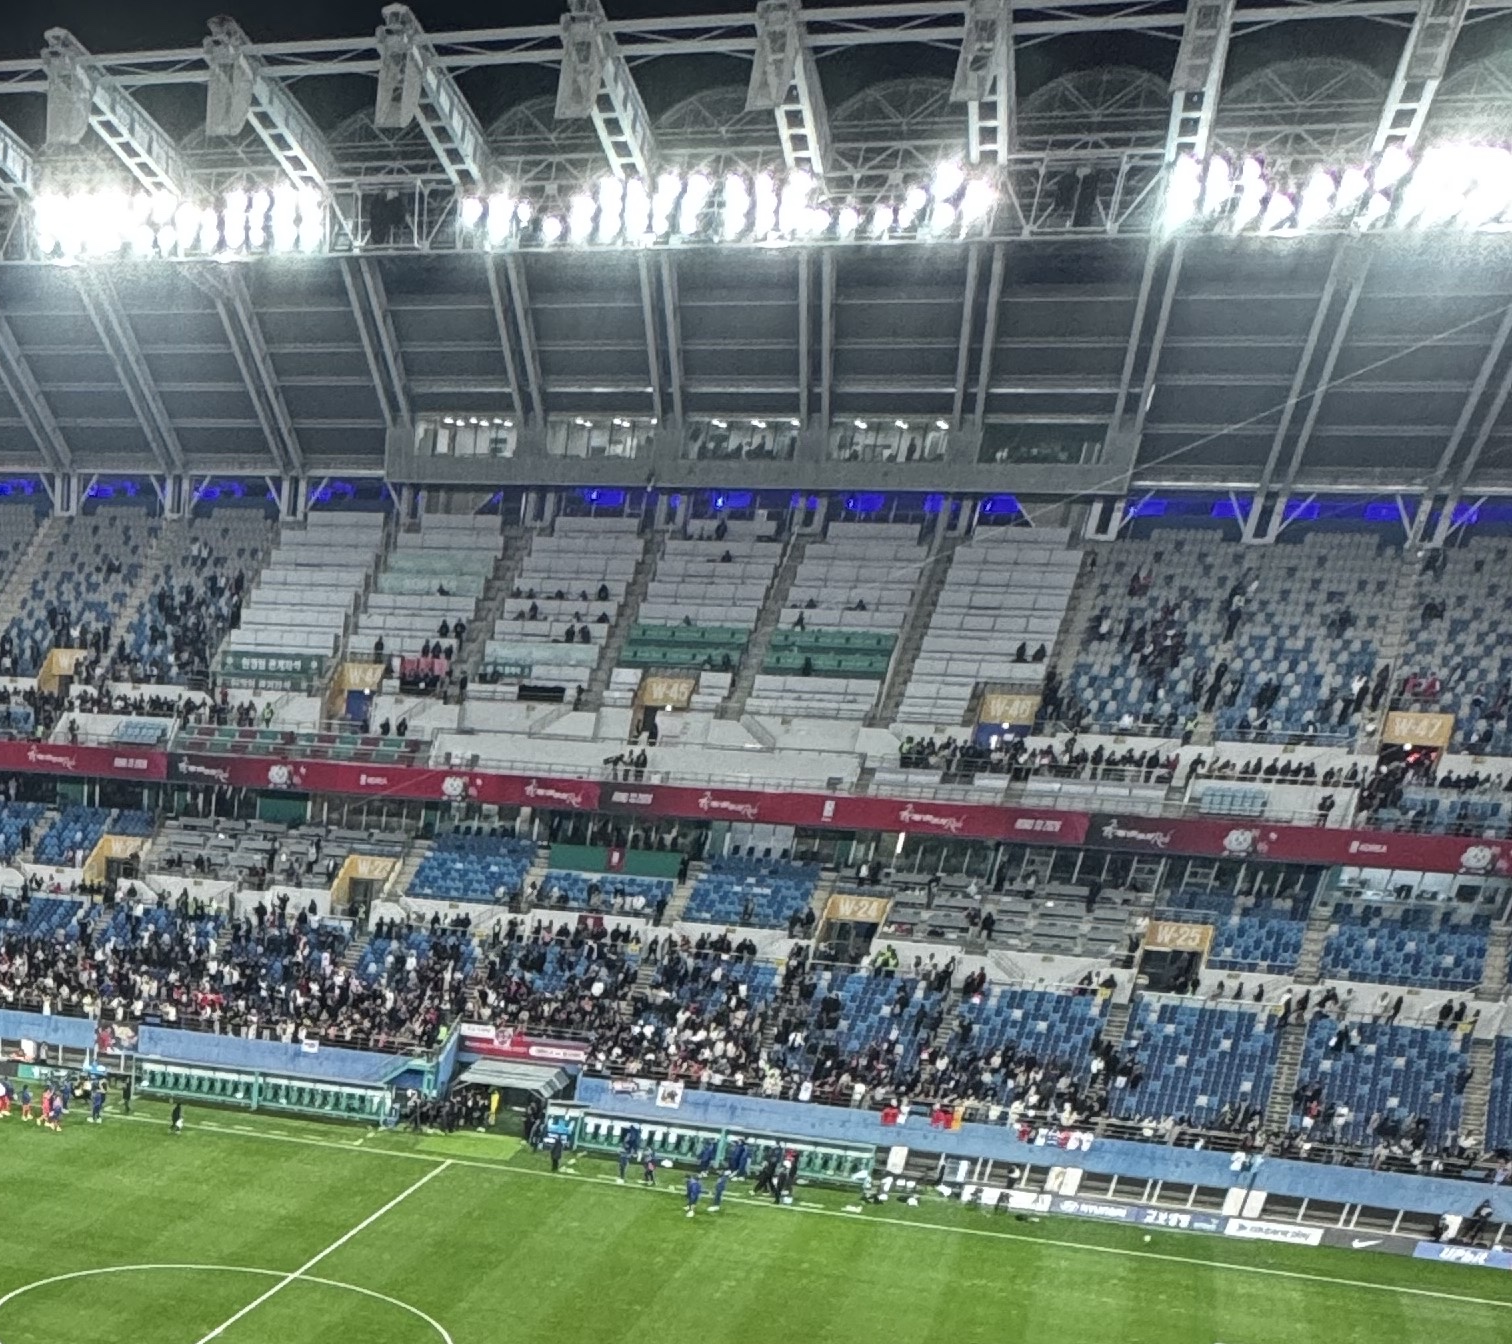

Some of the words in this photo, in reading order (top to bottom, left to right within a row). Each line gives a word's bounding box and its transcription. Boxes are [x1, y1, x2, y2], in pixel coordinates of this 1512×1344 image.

[1395, 717, 1443, 737] W-47
[839, 900, 878, 918] W-24
[1156, 928, 1200, 946] W-25
